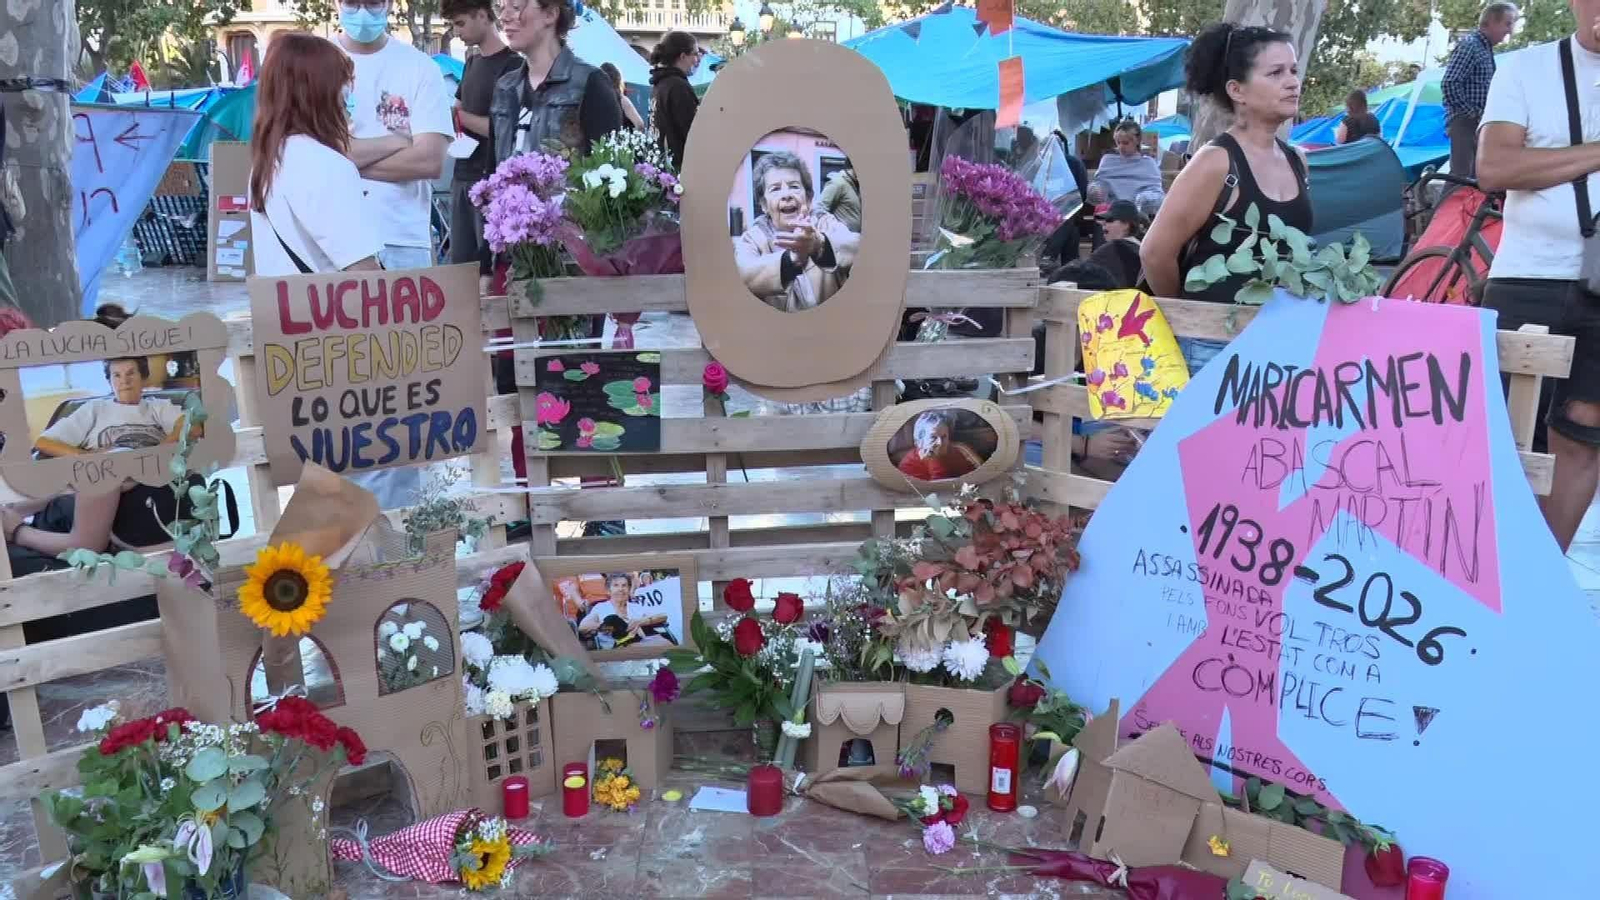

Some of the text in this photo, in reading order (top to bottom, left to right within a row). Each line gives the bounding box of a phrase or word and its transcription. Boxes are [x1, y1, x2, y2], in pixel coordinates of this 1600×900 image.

[276, 276, 446, 335] LUCHAD
[4, 326, 193, 360] LA LUCHA SIGUE!
[264, 323, 464, 397] DEFENDED
[291, 378, 442, 427] LO QUE ES
[1213, 351, 1472, 430] MARICARMEN
[290, 407, 478, 472] VUESTRO
[1241, 432, 1442, 497] ABASCAL
[72, 455, 161, 484] POR TI
[1132, 548, 1273, 607] ASSASSINADA
[1160, 586, 1195, 606] PELS
[1204, 595, 1248, 620] FONS
[1176, 613, 1207, 639] AMB
[1221, 624, 1306, 667] L'ESTAT
[1366, 663, 1381, 684] A
[1192, 733, 1214, 750] ALS
[1217, 744, 1282, 775] NOSTRES
